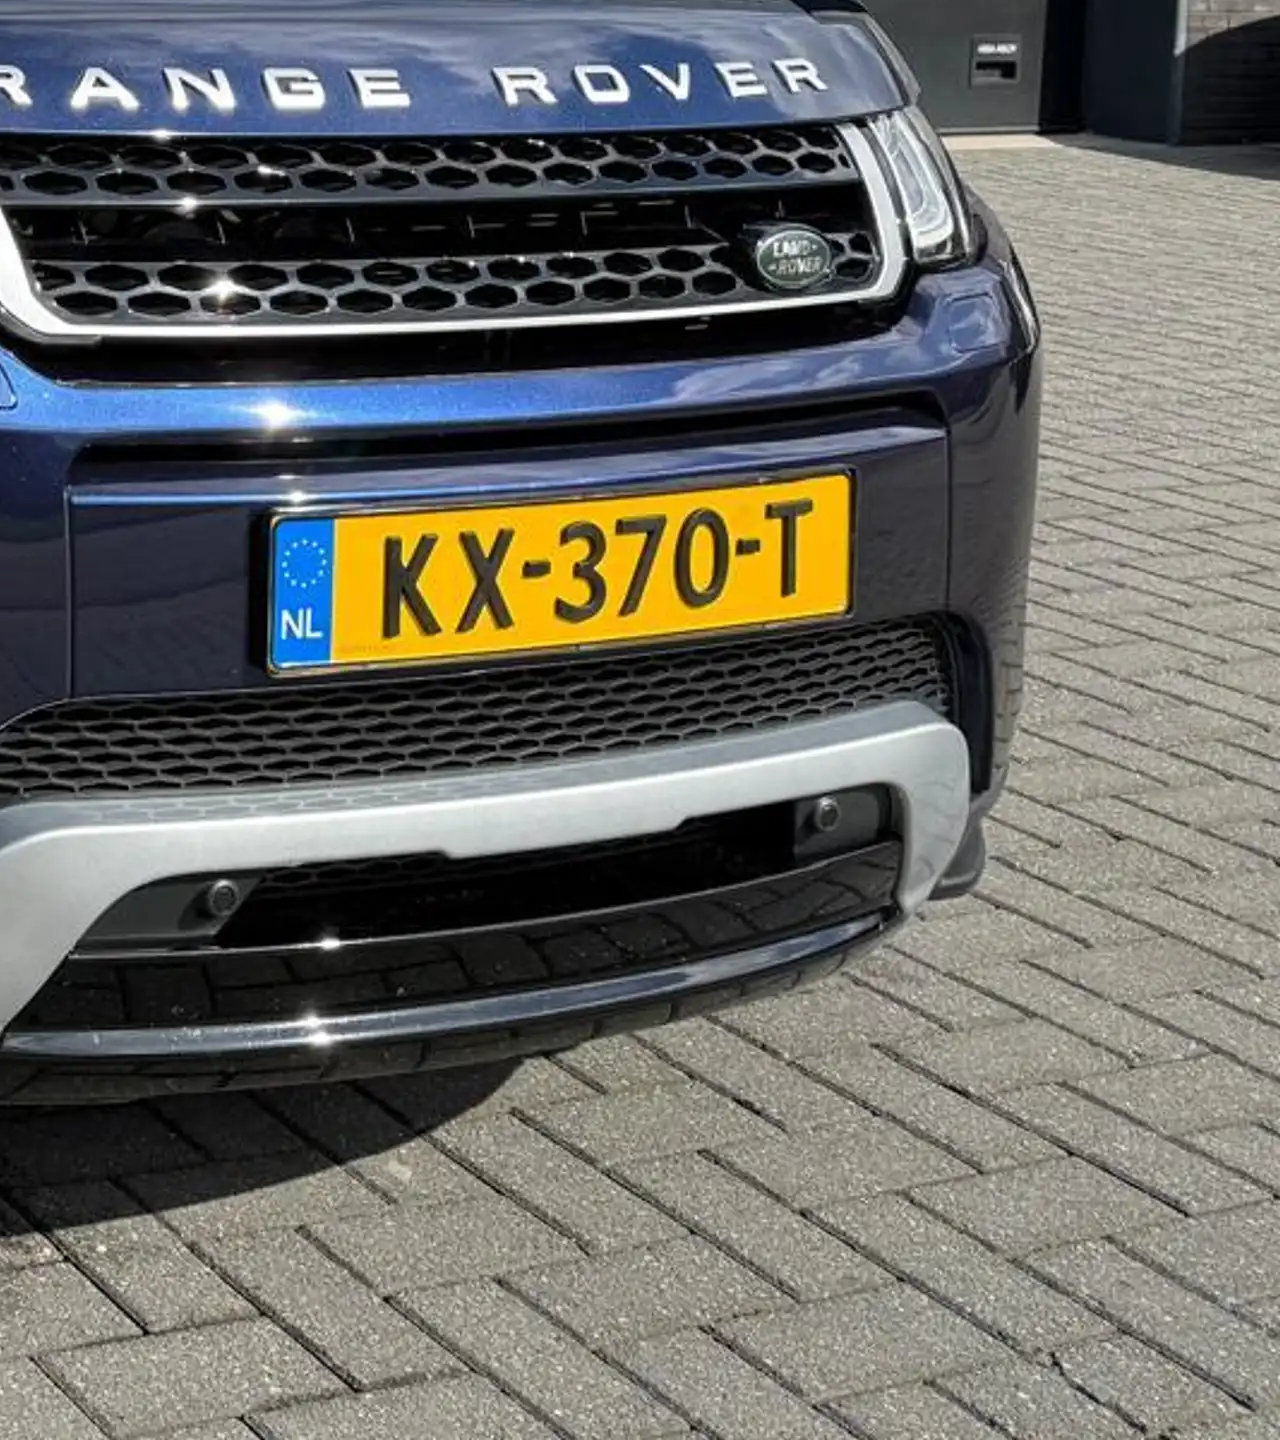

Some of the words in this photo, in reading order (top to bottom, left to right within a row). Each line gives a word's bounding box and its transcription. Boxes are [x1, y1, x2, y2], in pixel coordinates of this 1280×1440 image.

[492, 58, 829, 106] ROVER
[772, 239, 812, 257] LAND
[777, 257, 822, 276] ROVER
[383, 498, 813, 639] KX-370-T
[281, 609, 322, 640] NL
